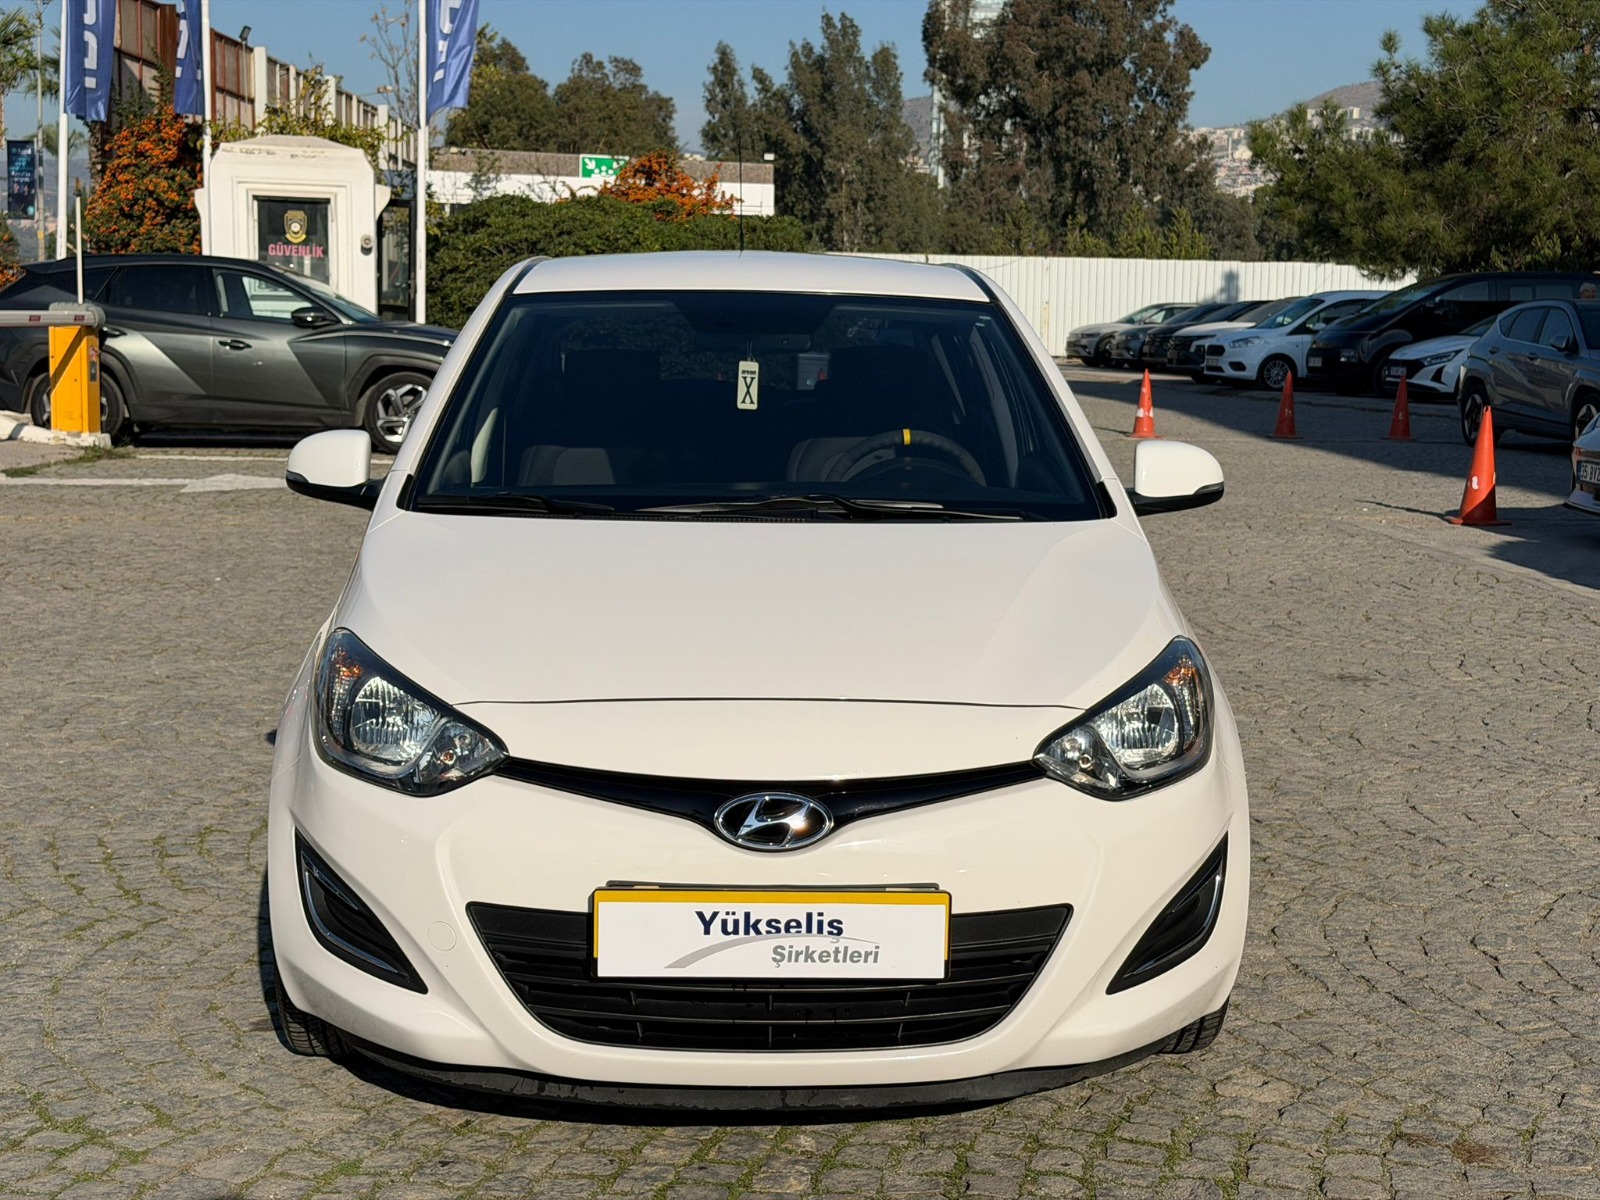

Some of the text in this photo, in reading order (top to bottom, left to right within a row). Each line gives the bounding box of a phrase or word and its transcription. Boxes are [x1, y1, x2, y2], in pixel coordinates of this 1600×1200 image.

[268, 241, 324, 258] GÜVENLİK
[740, 376, 756, 405] X
[694, 910, 844, 943] Yükseliş
[770, 944, 880, 968] Şirketleri
